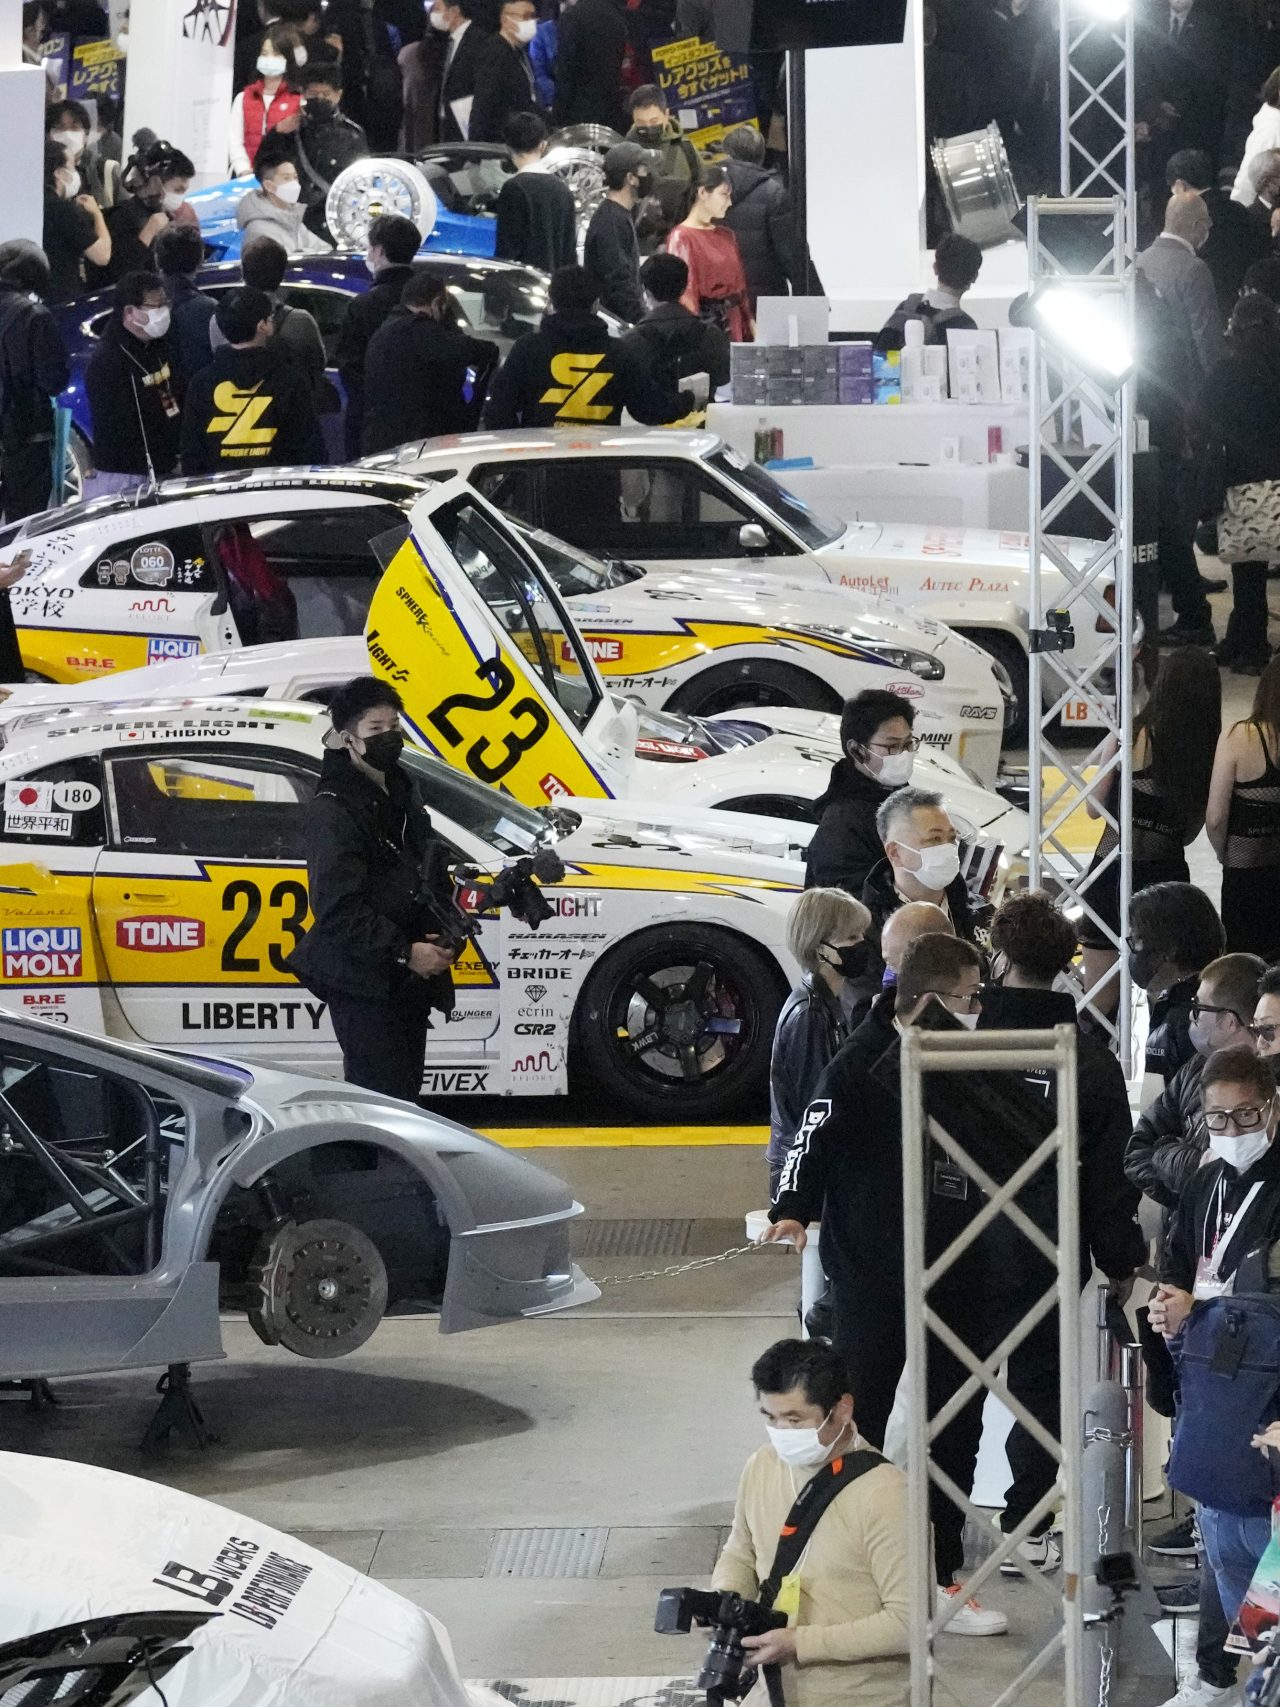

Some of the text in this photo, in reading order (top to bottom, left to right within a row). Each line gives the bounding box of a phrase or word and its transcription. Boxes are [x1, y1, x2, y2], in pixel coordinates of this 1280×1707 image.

[141, 556, 164, 568] 060
[9, 586, 75, 598] OKYO
[150, 639, 200, 656] LIQUI
[566, 641, 619, 659] TNE
[427, 658, 550, 783] 23
[960, 705, 997, 720] RAYS
[150, 729, 231, 739] T.HIBINO
[920, 733, 953, 742] MINI
[7, 815, 71, 833] 世界平和
[122, 922, 199, 946] TONE
[220, 879, 312, 975] 23
[5, 929, 79, 952] LIQUI
[6, 953, 81, 977] MOLY
[507, 967, 573, 980] BRIDE
[182, 1002, 329, 1030] LIBERTY
[514, 1023, 557, 1036] CSR2
